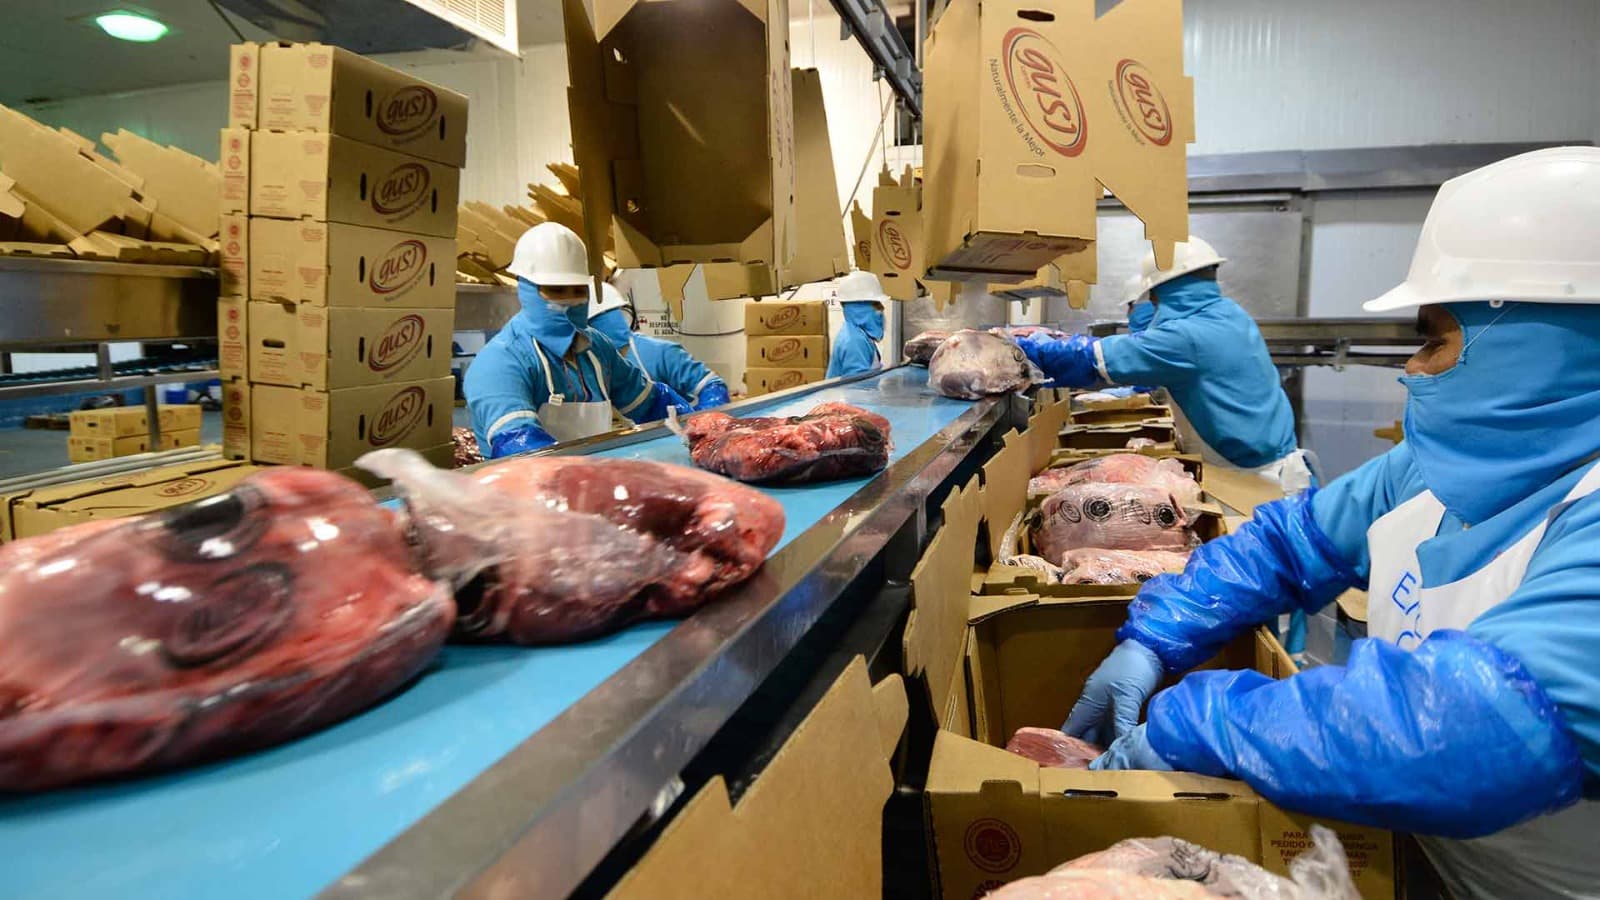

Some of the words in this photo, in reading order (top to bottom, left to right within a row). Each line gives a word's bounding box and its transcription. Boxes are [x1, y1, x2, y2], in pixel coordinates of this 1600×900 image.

[990, 58, 1018, 123] Naturalmente
[1022, 131, 1046, 157] Mejor
[1283, 831, 1309, 839] PARA
[1270, 840, 1306, 848] PEDIDO
